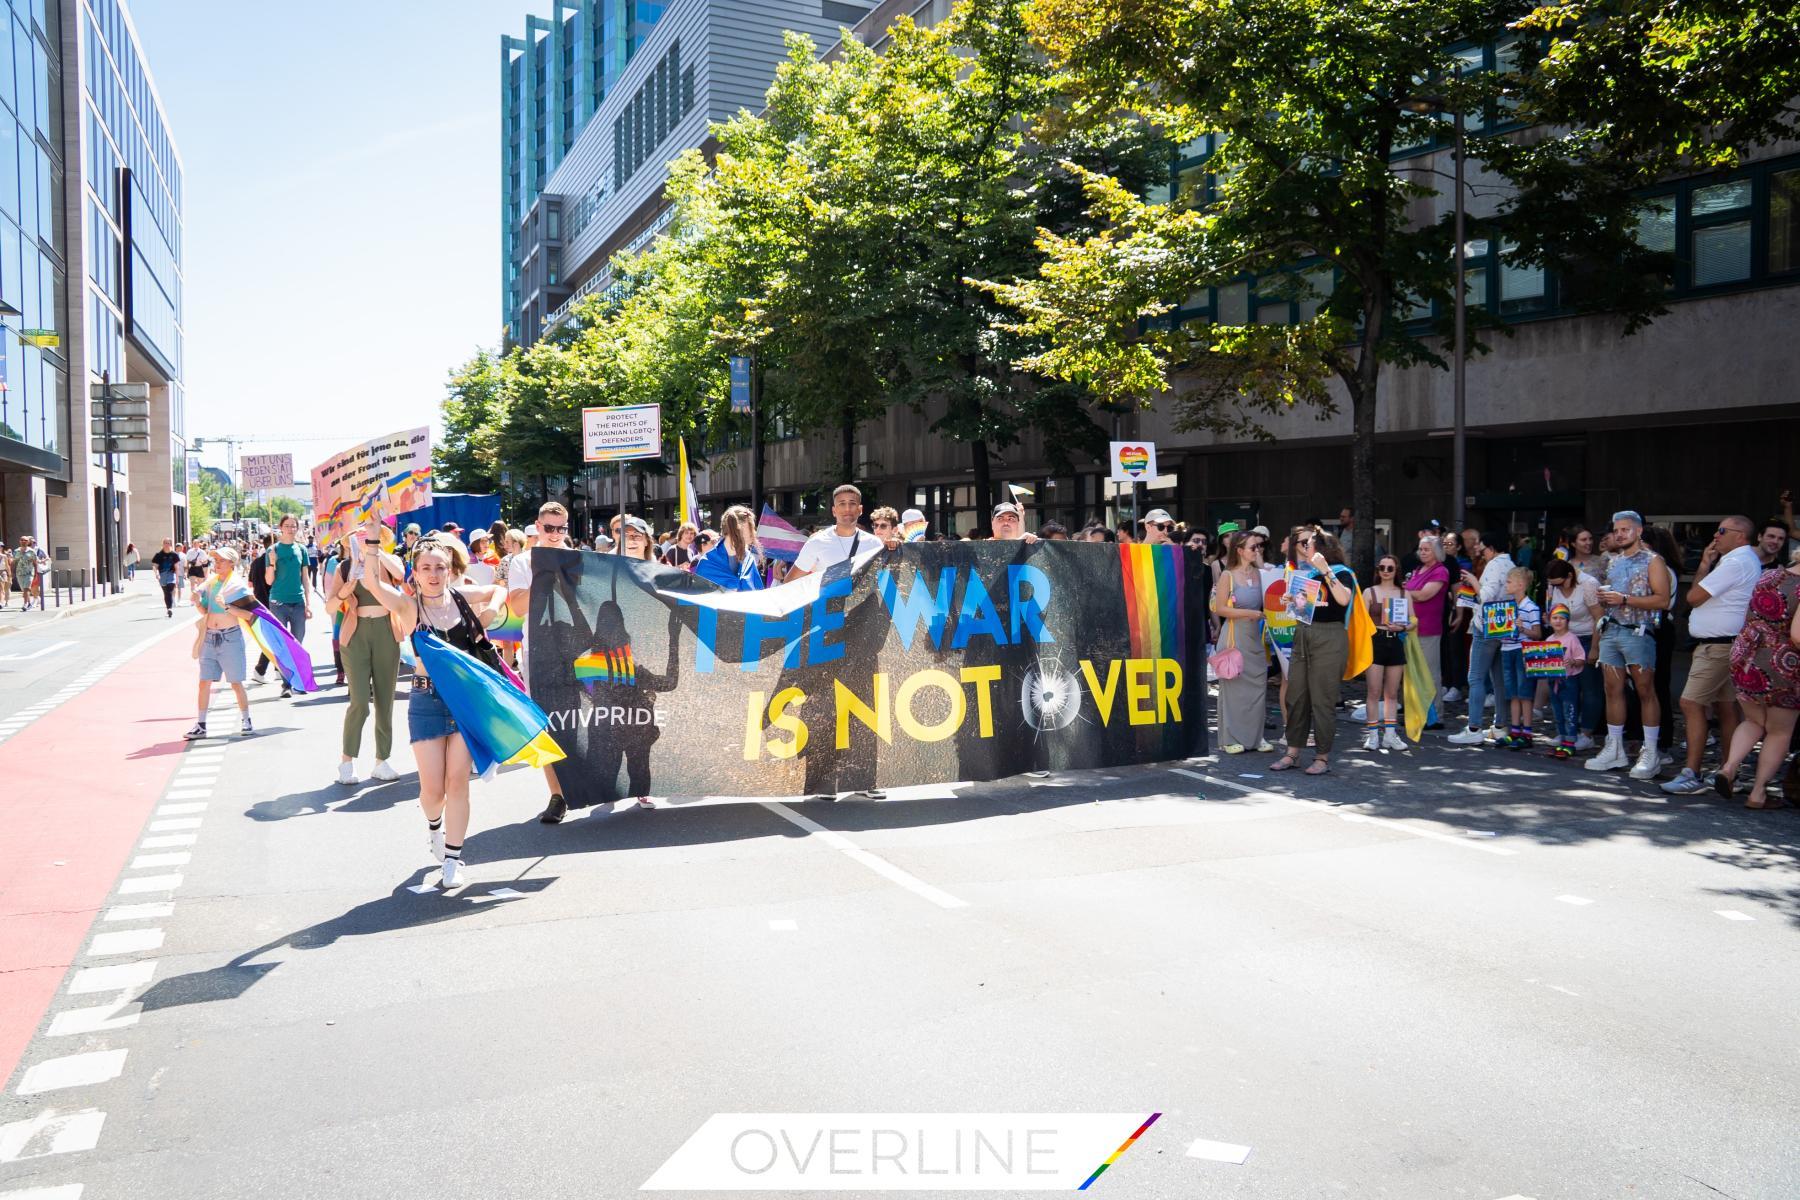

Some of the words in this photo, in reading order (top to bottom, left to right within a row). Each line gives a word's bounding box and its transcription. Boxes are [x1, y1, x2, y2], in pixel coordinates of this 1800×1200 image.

[606, 413, 638, 421] PROTECT
[588, 429, 628, 437] UKRAINIAN
[629, 427, 656, 435] LGBTQ+
[601, 436, 644, 444] DEFENDERS
[247, 455, 266, 466] MIT
[269, 454, 292, 464] UNS
[321, 465, 335, 478] Wir
[336, 454, 355, 470] sind
[356, 448, 370, 461] für
[371, 443, 392, 457] jene
[394, 439, 409, 448] da,
[411, 434, 426, 445] die
[242, 465, 271, 477] REDEN
[331, 478, 340, 488] an
[342, 470, 356, 482] der
[358, 460, 380, 473] Front
[382, 455, 397, 465] für
[399, 452, 417, 461] uns
[274, 473, 293, 486] UNS
[351, 472, 390, 492] kämpfen
[876, 562, 1057, 654] WAR
[743, 686, 809, 761] IS
[834, 665, 1002, 751] NOT
